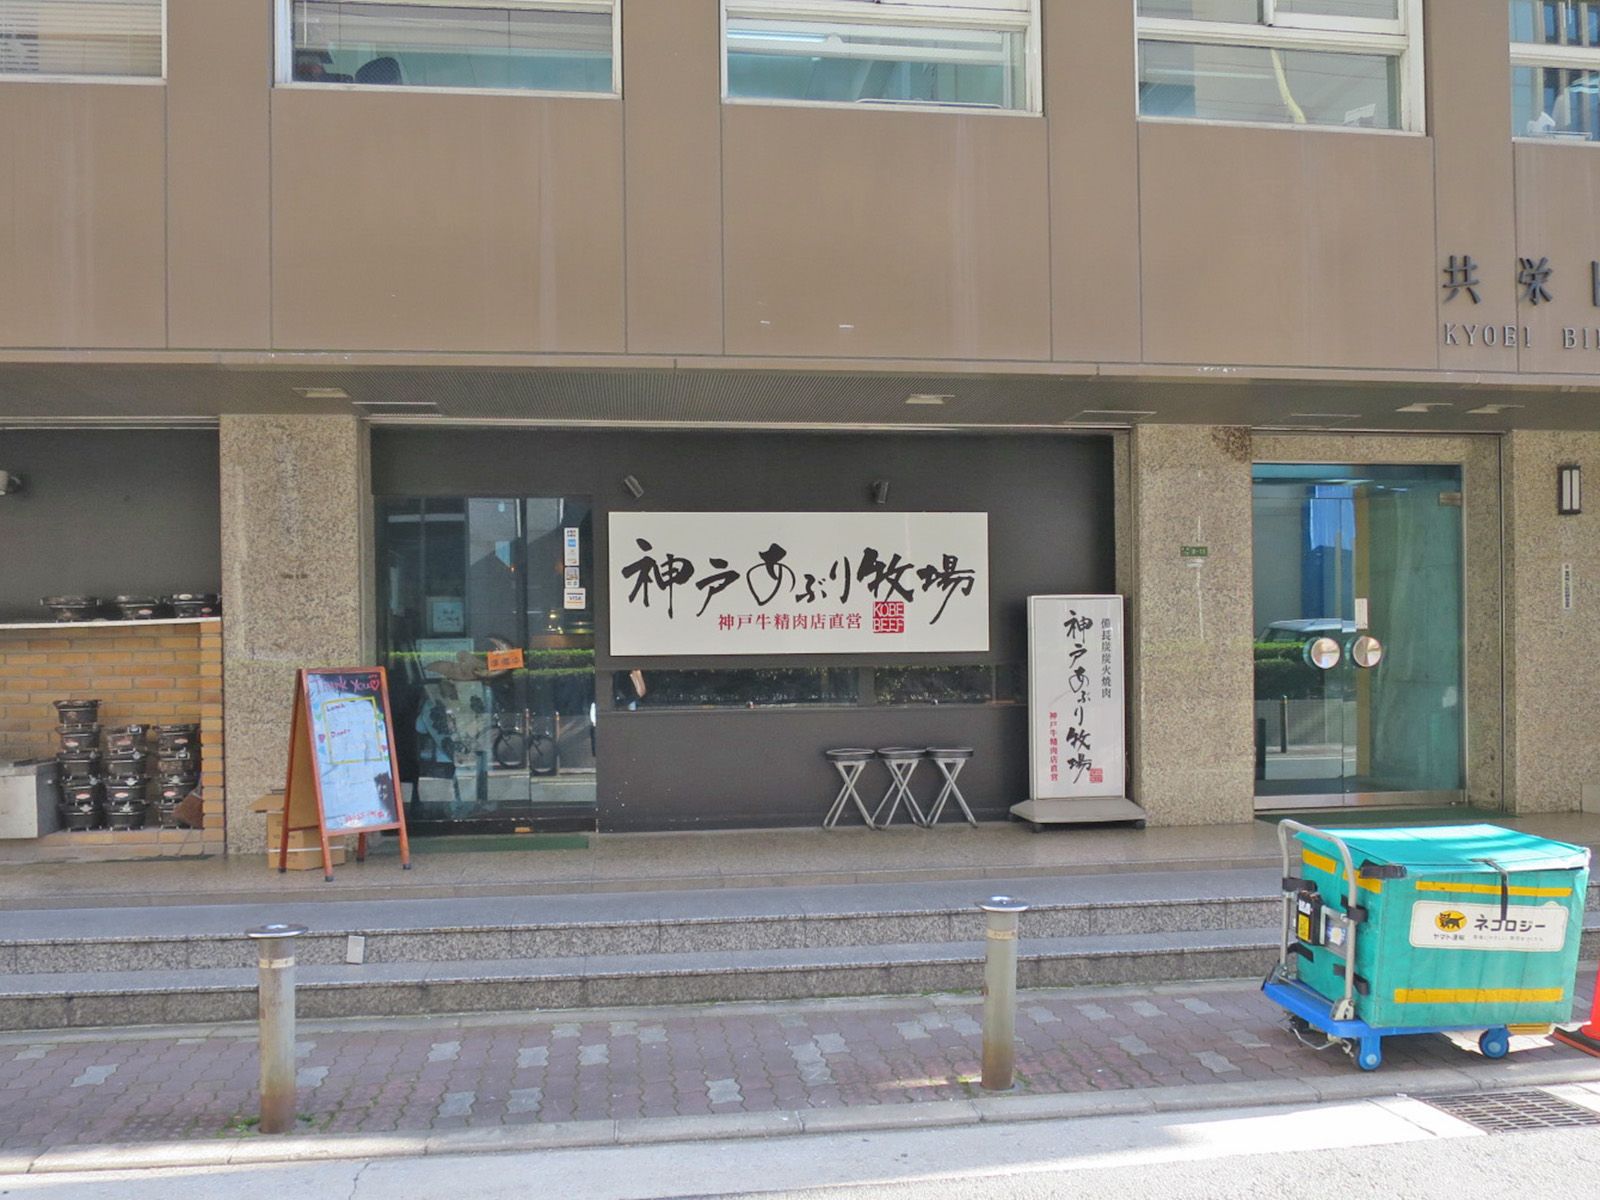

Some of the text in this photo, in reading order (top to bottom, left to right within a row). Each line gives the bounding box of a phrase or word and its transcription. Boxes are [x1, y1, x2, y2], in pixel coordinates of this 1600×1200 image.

[1443, 255, 1600, 307] 共栄
[1444, 323, 1532, 348] KYOEI
[622, 538, 976, 625] 神戸あぶり牧場
[873, 602, 905, 617] KOBE
[717, 613, 863, 631] 神戸牛精肉店直営
[873, 618, 905, 632] BEEF
[1064, 610, 1094, 785] 神戸あぶり牧場
[1473, 914, 1547, 932] ネコロジー
